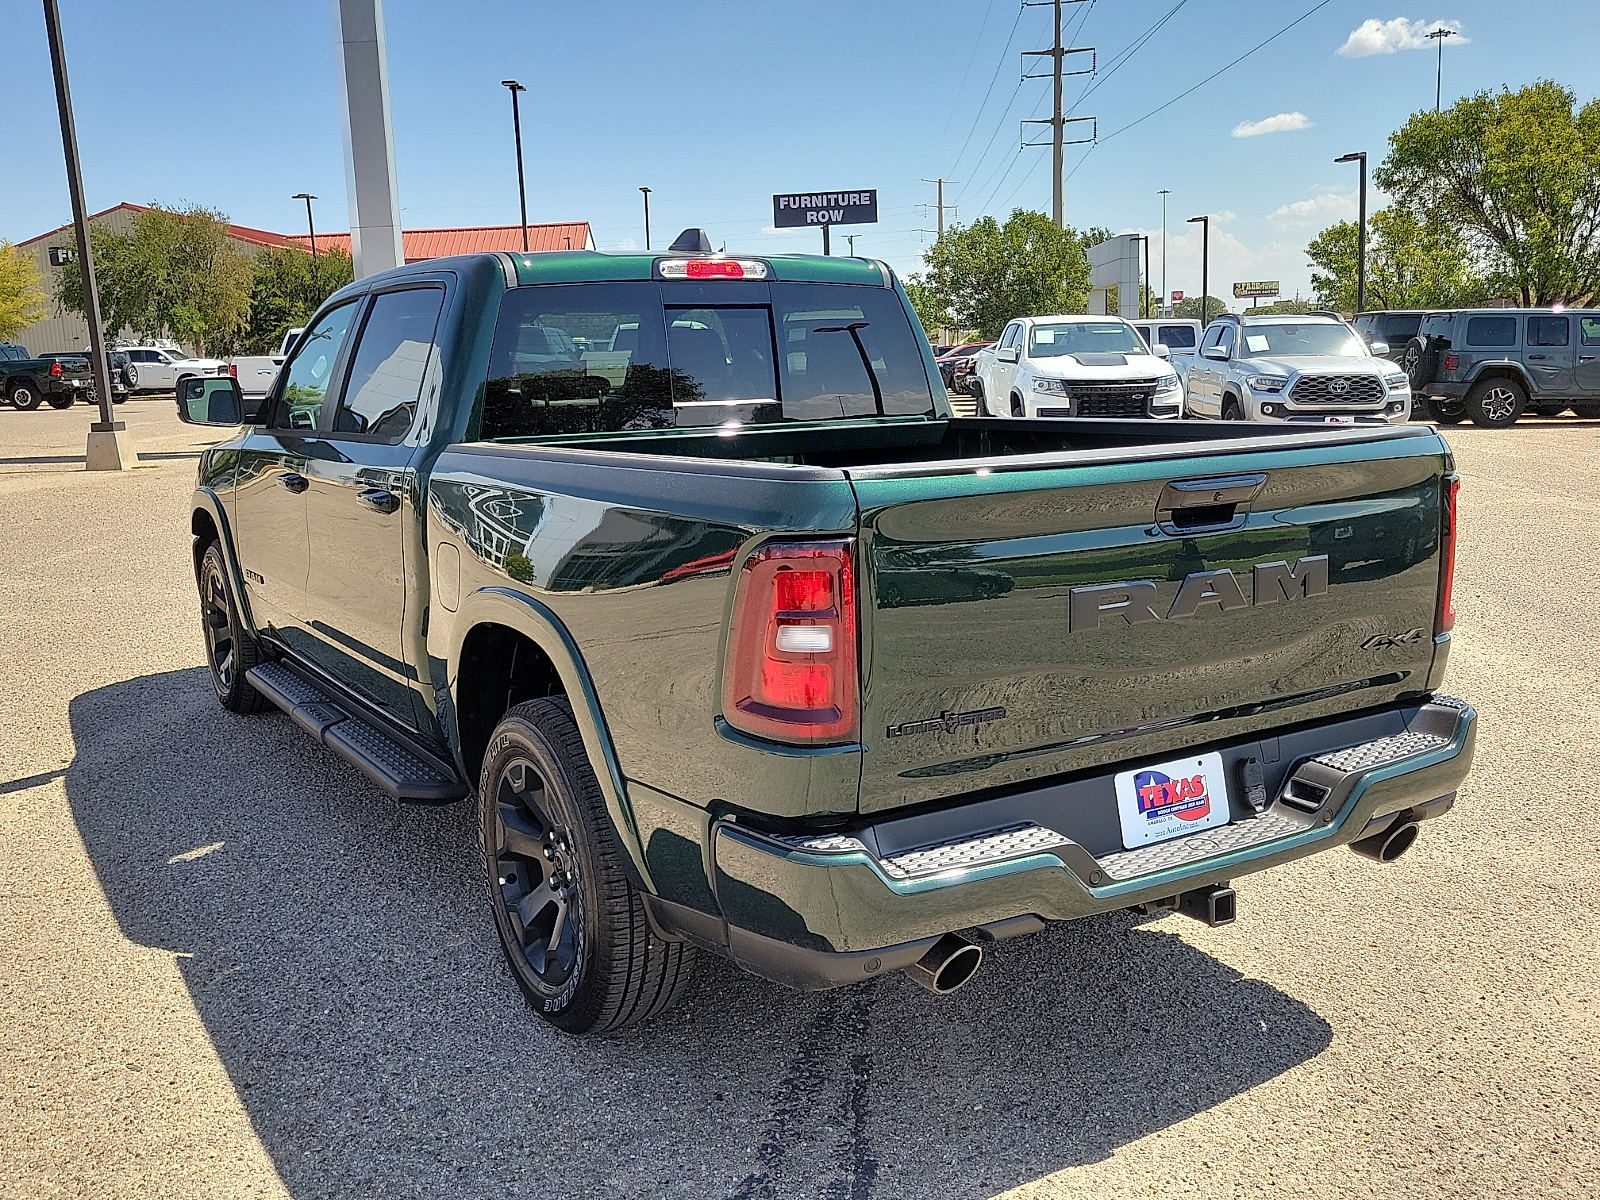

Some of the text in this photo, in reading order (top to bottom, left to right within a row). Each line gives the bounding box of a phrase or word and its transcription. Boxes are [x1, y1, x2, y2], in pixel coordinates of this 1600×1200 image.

[779, 193, 871, 210] FURNITURE
[806, 209, 844, 224] ROW
[1069, 554, 1329, 633] RAM
[886, 706, 1007, 739] LONE STAR
[1138, 774, 1205, 810] TEXAS
